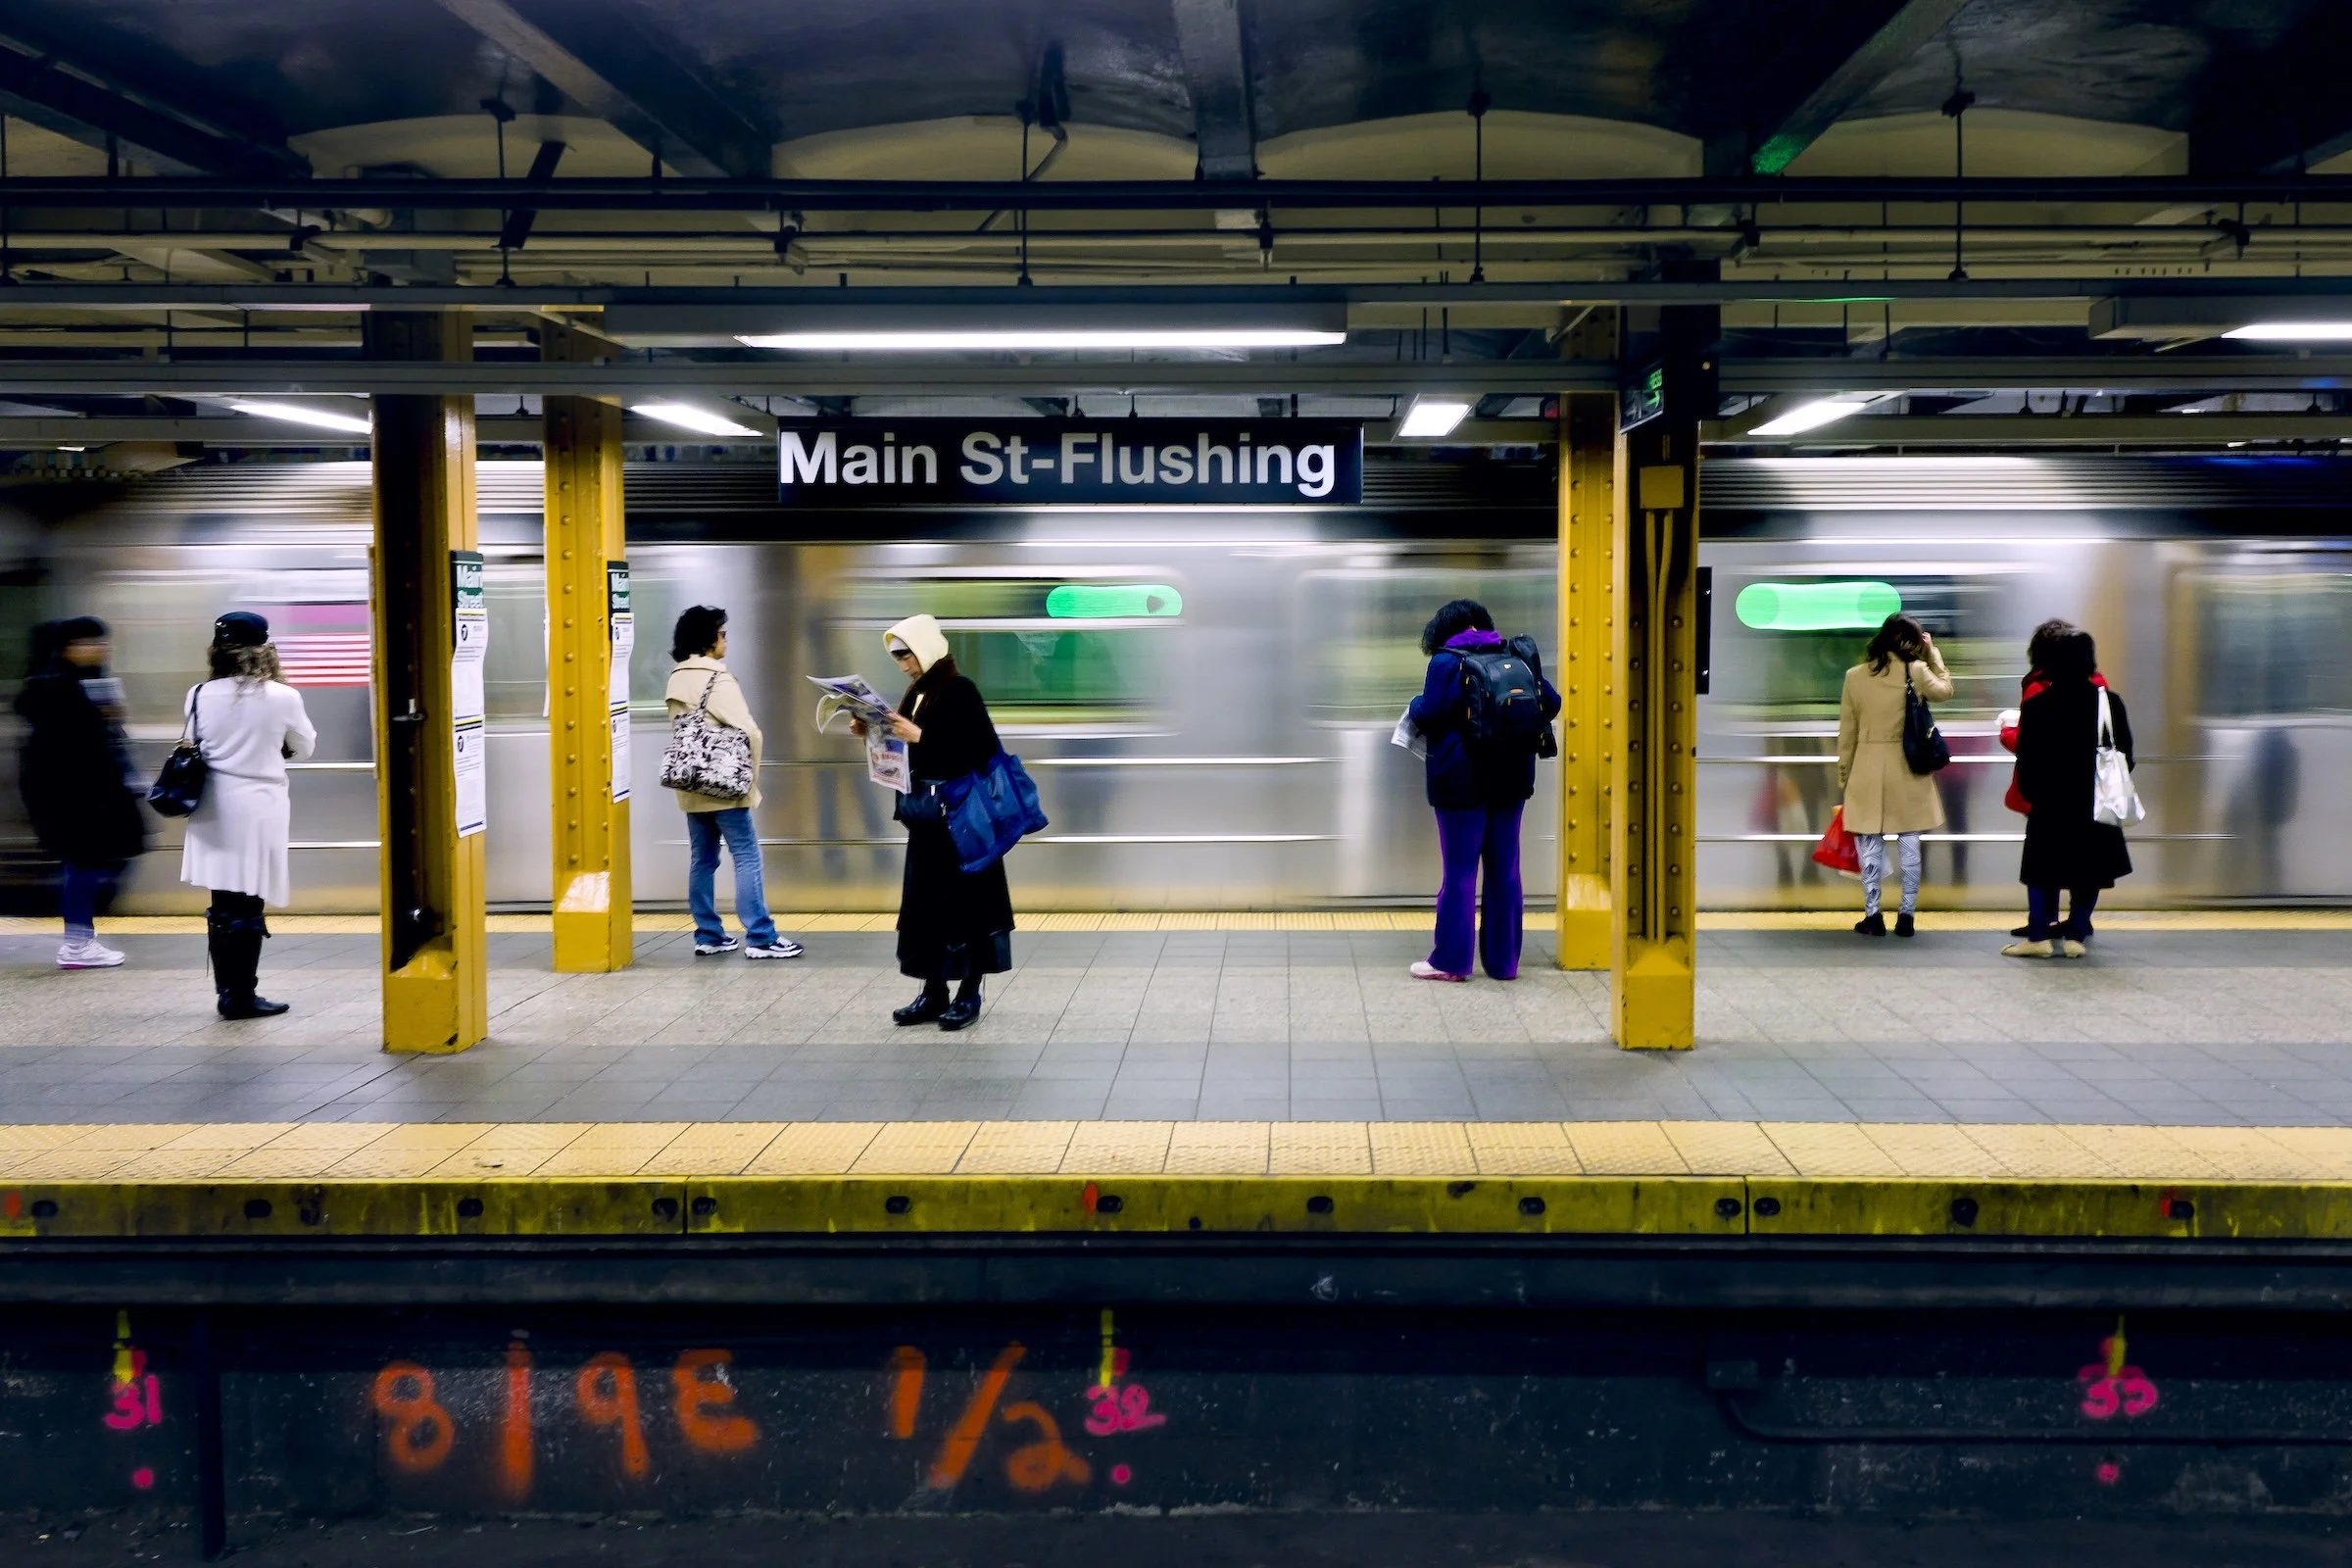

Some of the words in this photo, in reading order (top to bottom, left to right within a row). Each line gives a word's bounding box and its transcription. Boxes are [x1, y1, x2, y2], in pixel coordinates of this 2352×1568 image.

[780, 432, 937, 485] Main
[960, 431, 1336, 498] St-Flushing
[105, 1375, 162, 1431] 31
